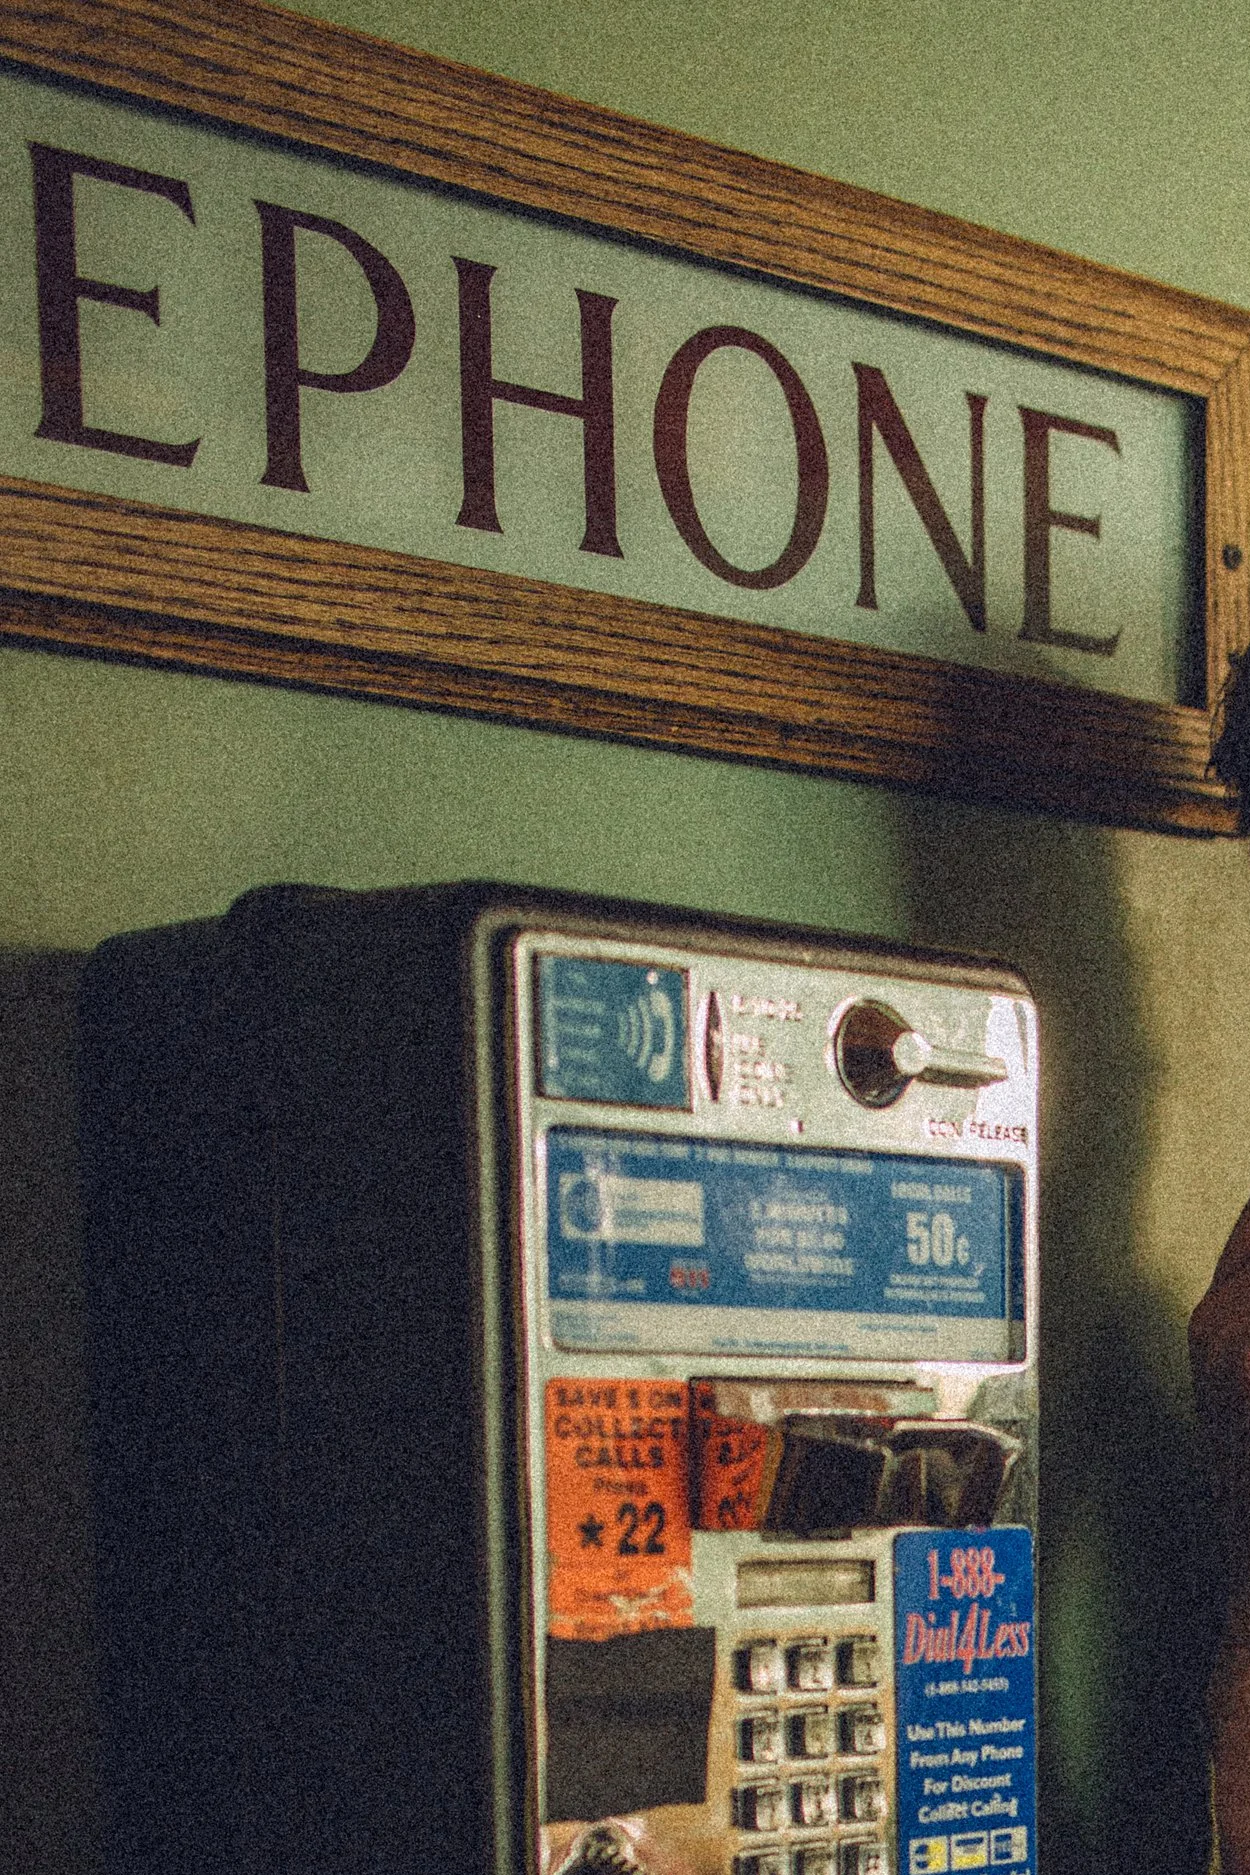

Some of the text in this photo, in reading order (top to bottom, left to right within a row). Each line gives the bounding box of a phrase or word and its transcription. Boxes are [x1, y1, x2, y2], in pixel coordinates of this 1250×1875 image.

[29, 139, 1123, 656] EPHONE
[928, 1118, 1029, 1145] COIN RELEASE
[906, 1210, 970, 1267] 50¢
[554, 1414, 684, 1441] COLLECT
[575, 1444, 665, 1469] CALLS
[927, 1546, 1006, 1601] 1-888-
[902, 1601, 1031, 1676] Dial4Less
[907, 1715, 1027, 1742] Use This Number
[909, 1744, 1024, 1770] From Any Phone
[923, 1773, 1012, 1796] For Discount
[917, 1792, 1019, 1824] Collect Calling
